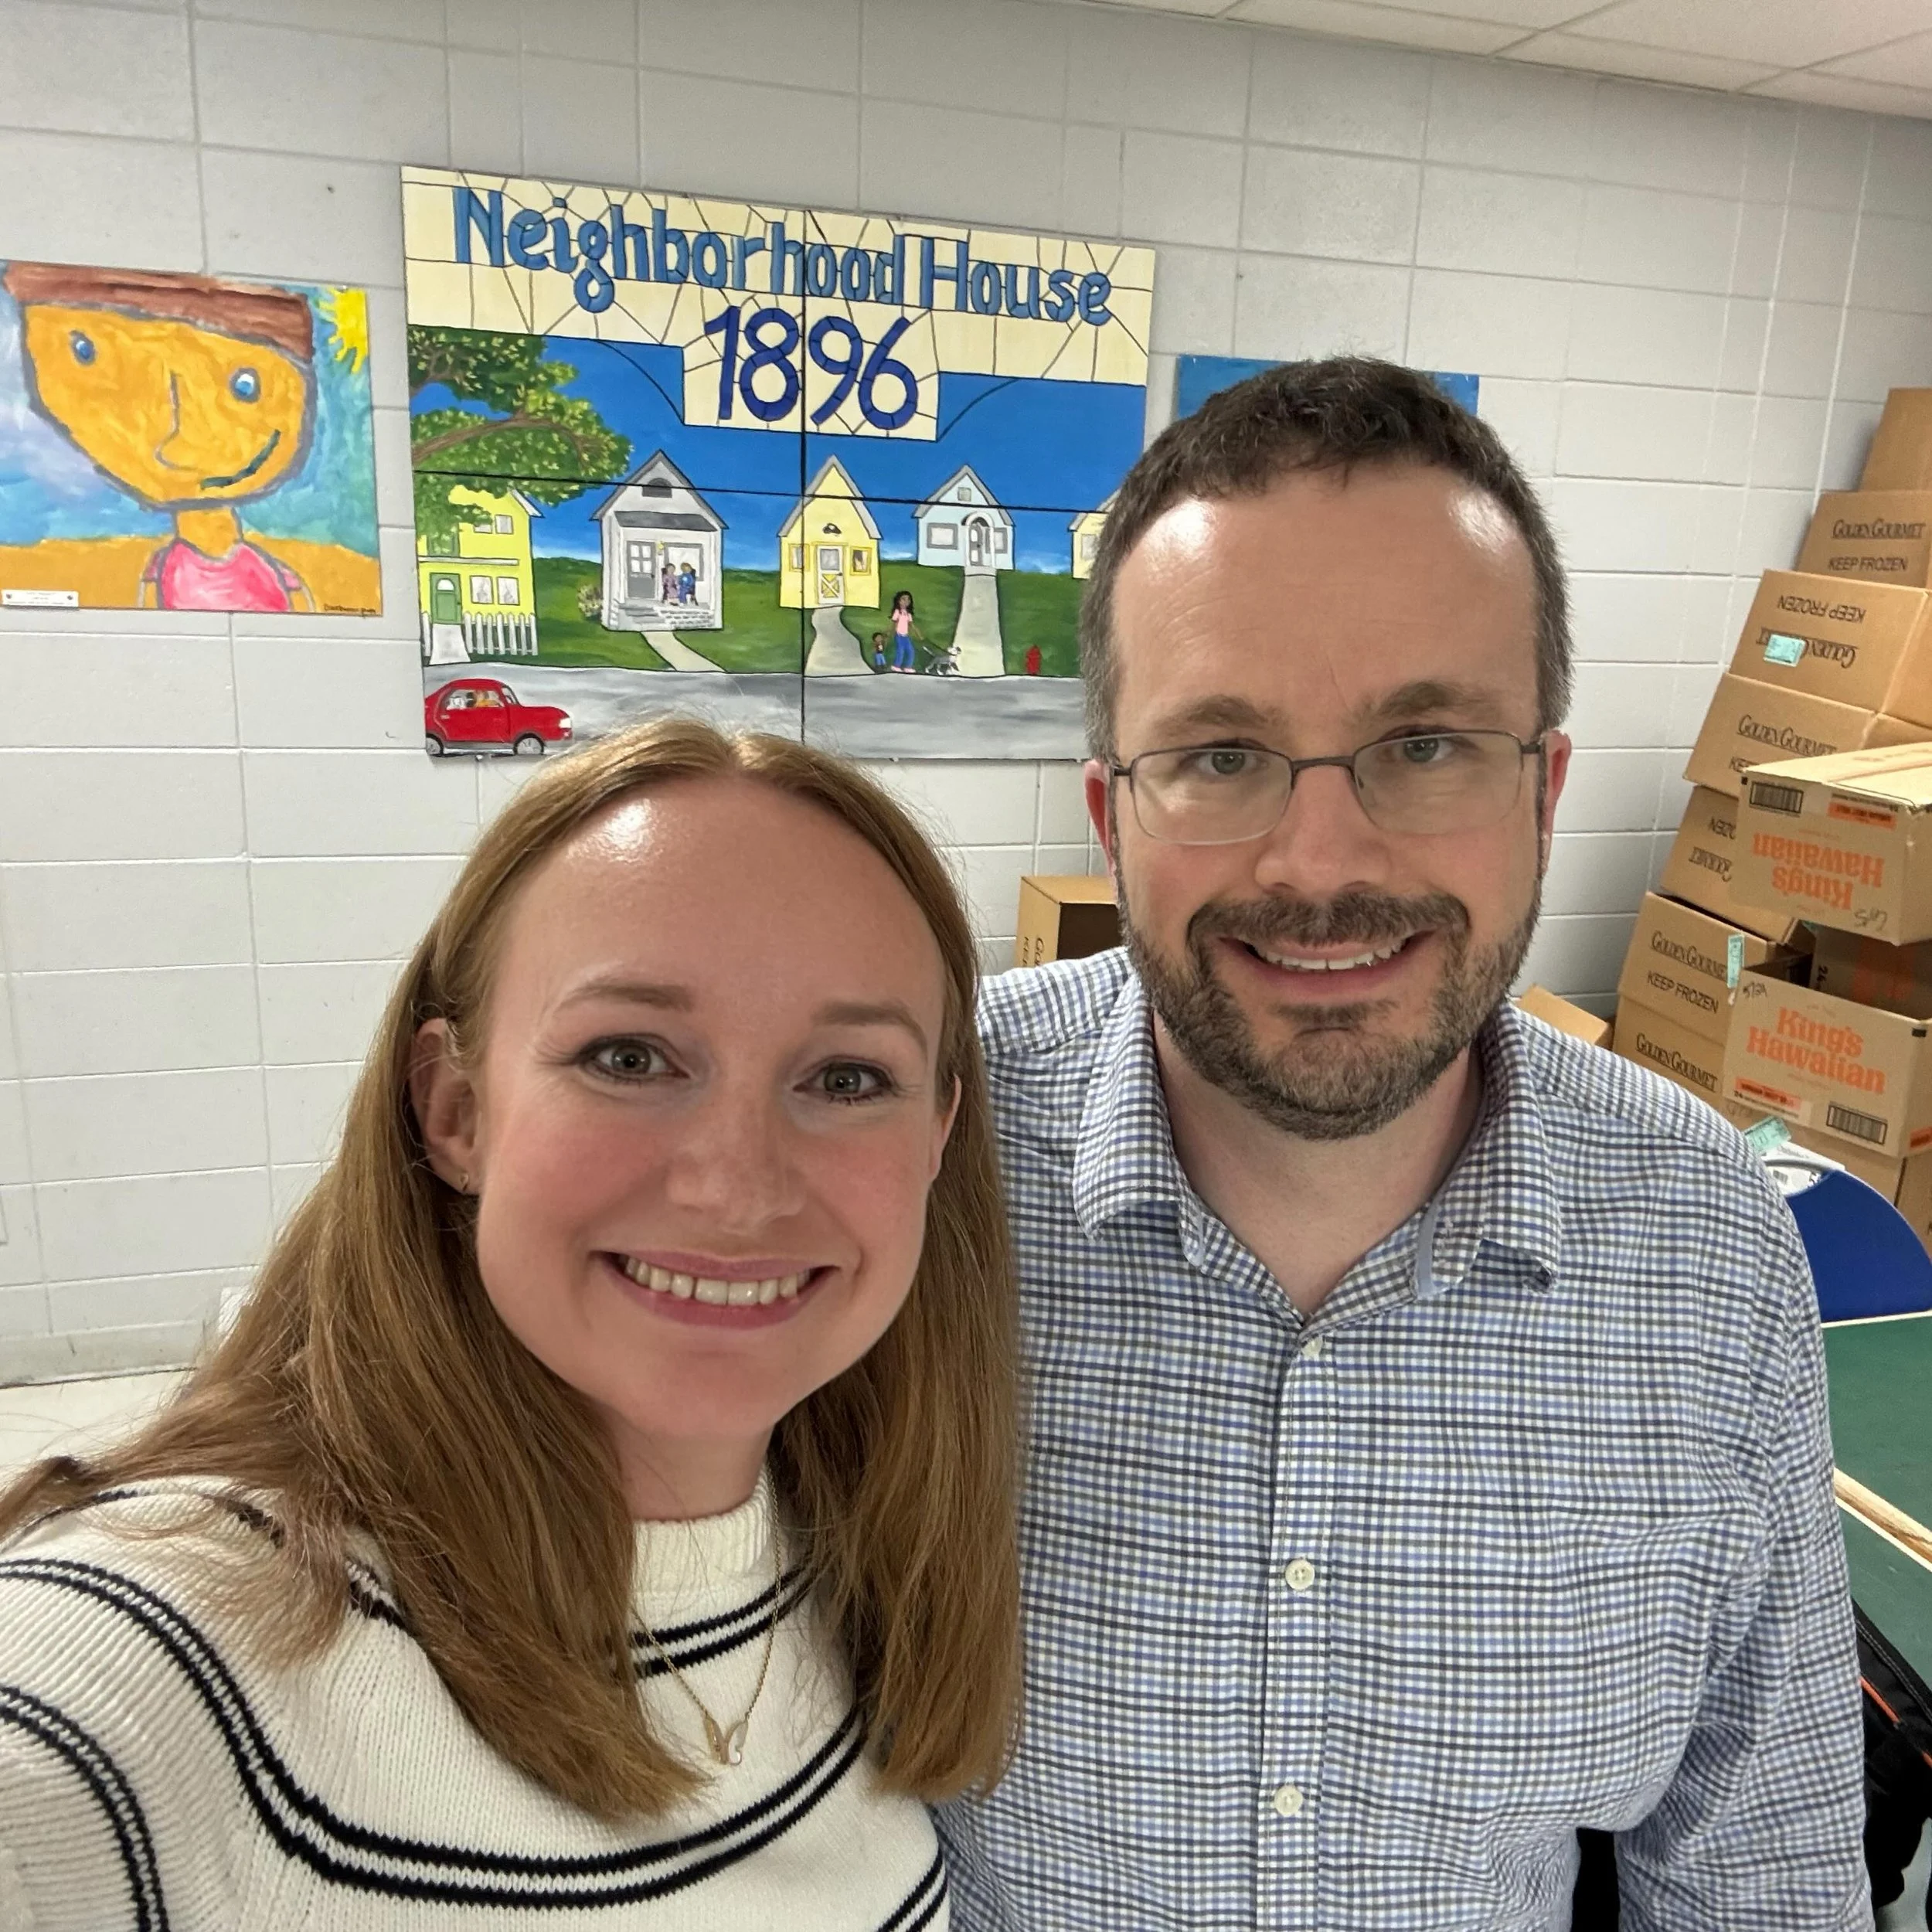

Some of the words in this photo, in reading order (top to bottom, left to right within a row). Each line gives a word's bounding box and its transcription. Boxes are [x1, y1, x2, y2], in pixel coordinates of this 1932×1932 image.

[451, 186, 905, 313] Neighborhood
[919, 236, 1111, 326] House
[704, 304, 918, 430] 1896
[1828, 556, 1859, 570] KEEP
[1860, 556, 1906, 570] FROZEN
[1777, 595, 1828, 617] FROZEN
[1828, 604, 1866, 623] KEEP
[1752, 832, 1884, 888] Hawaiian
[1648, 971, 1675, 991] KEEP
[1675, 982, 1719, 1014] FROZEN
[1777, 1005, 1864, 1058] King's
[1746, 1026, 1886, 1095] Hawaiian
